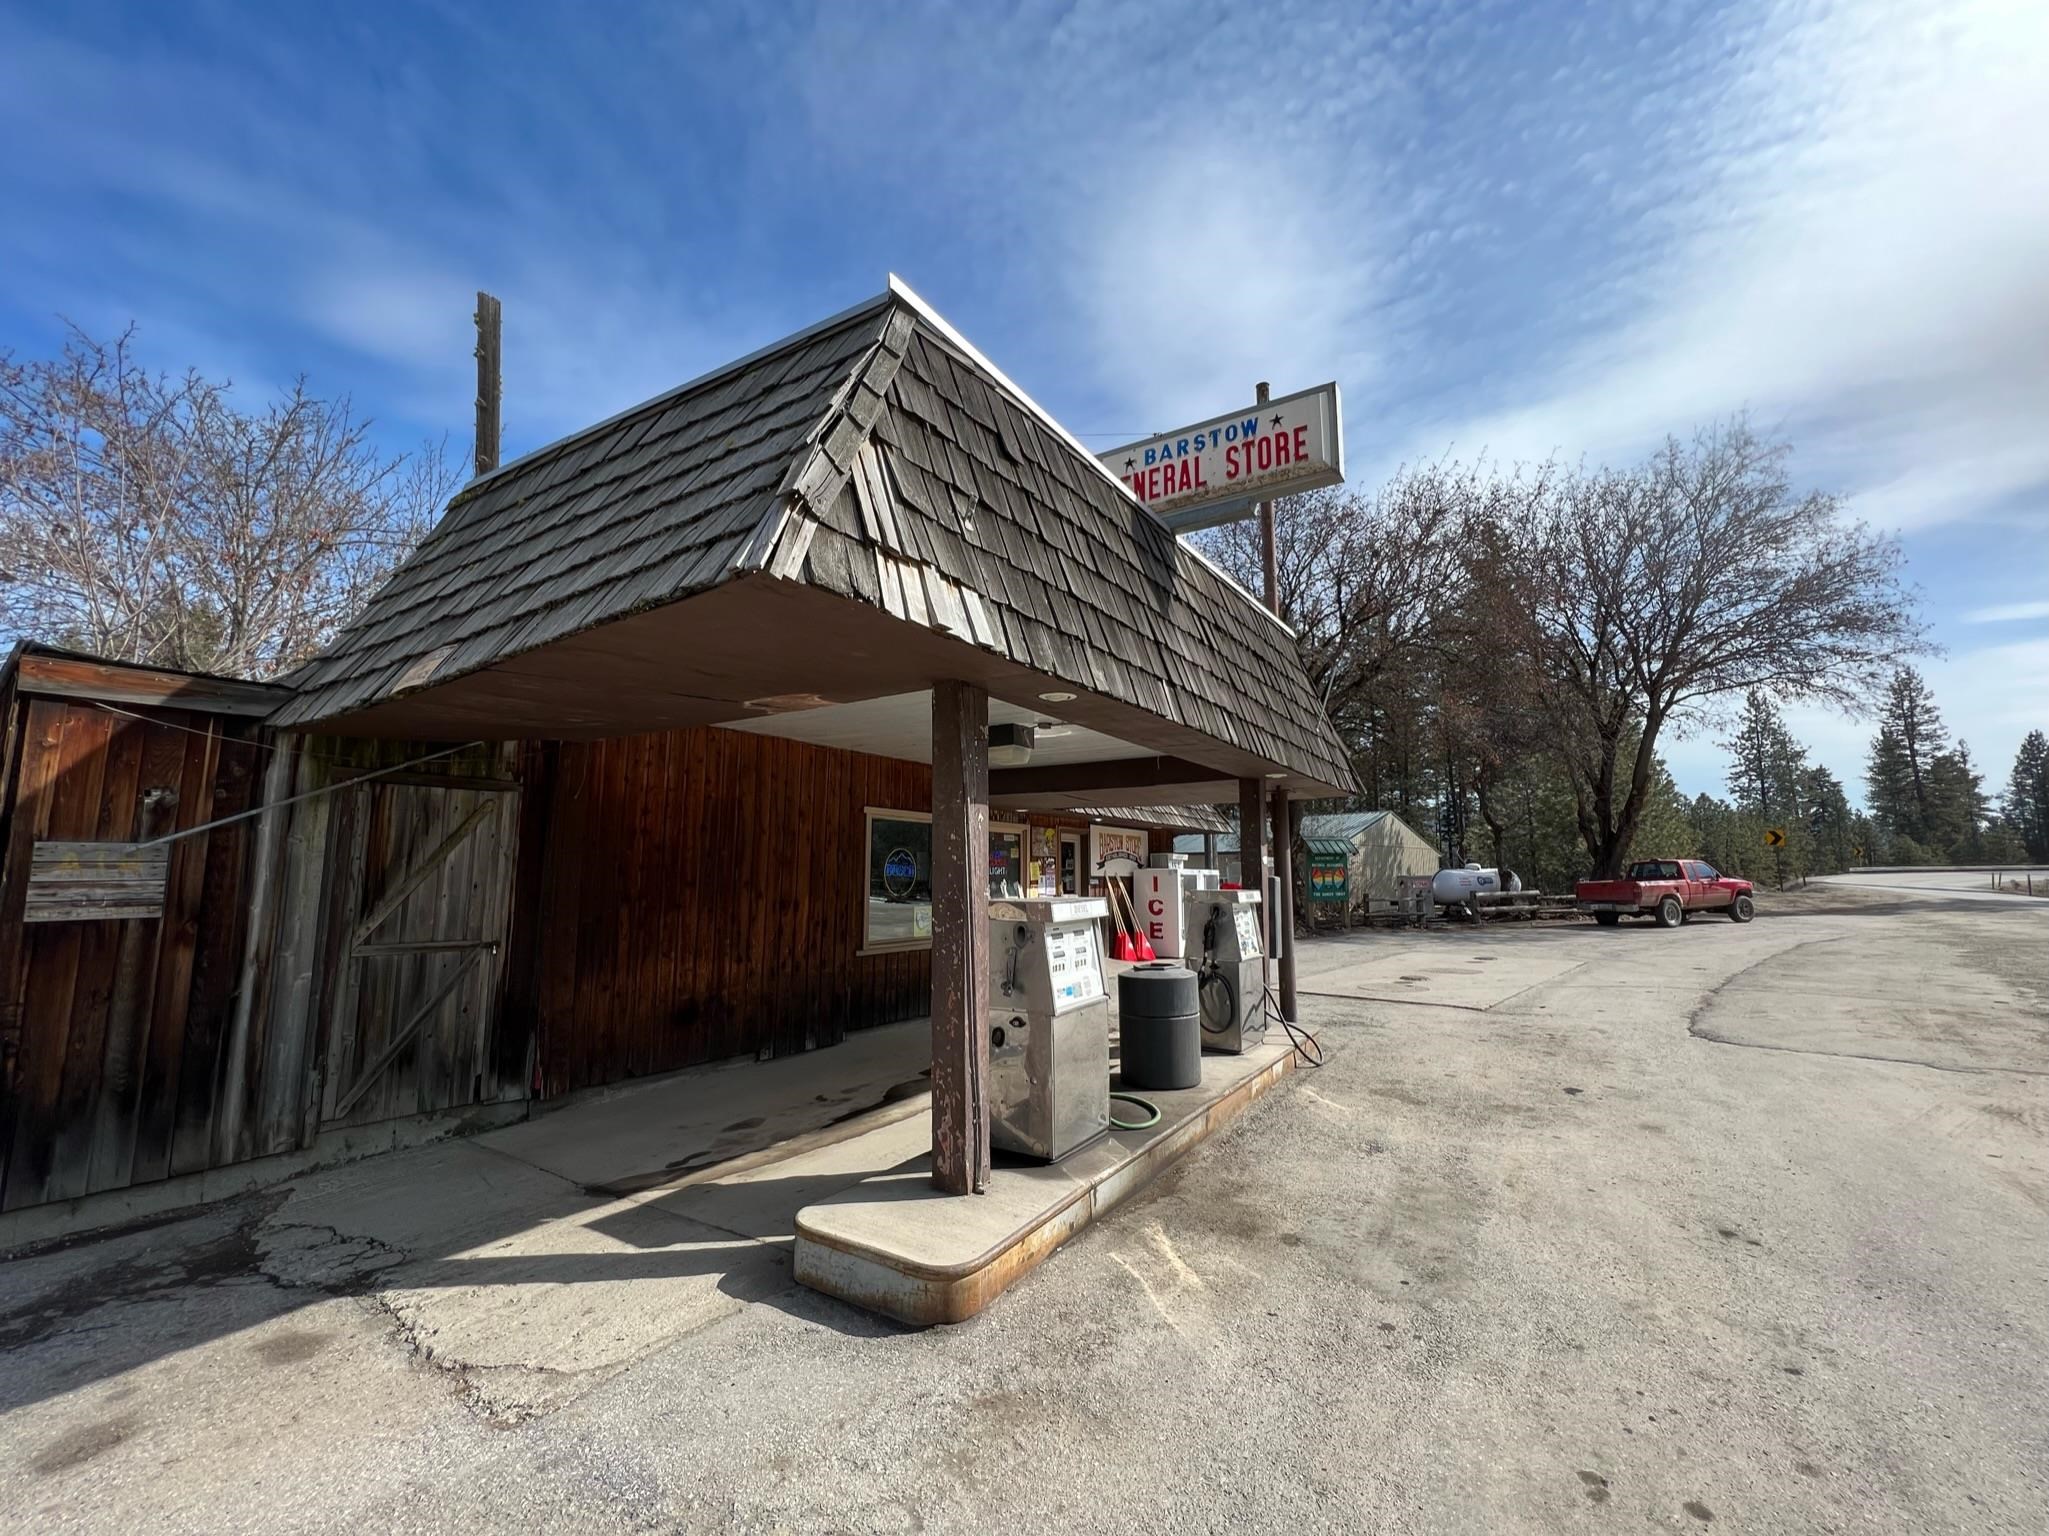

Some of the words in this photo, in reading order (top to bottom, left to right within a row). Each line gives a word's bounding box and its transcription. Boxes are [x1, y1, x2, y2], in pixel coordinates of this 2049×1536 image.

[1121, 456, 1207, 503] NERAL
[1226, 424, 1309, 480] STORE
[1144, 417, 1259, 466] BARSTOW
[1148, 875, 1164, 940] ICE
